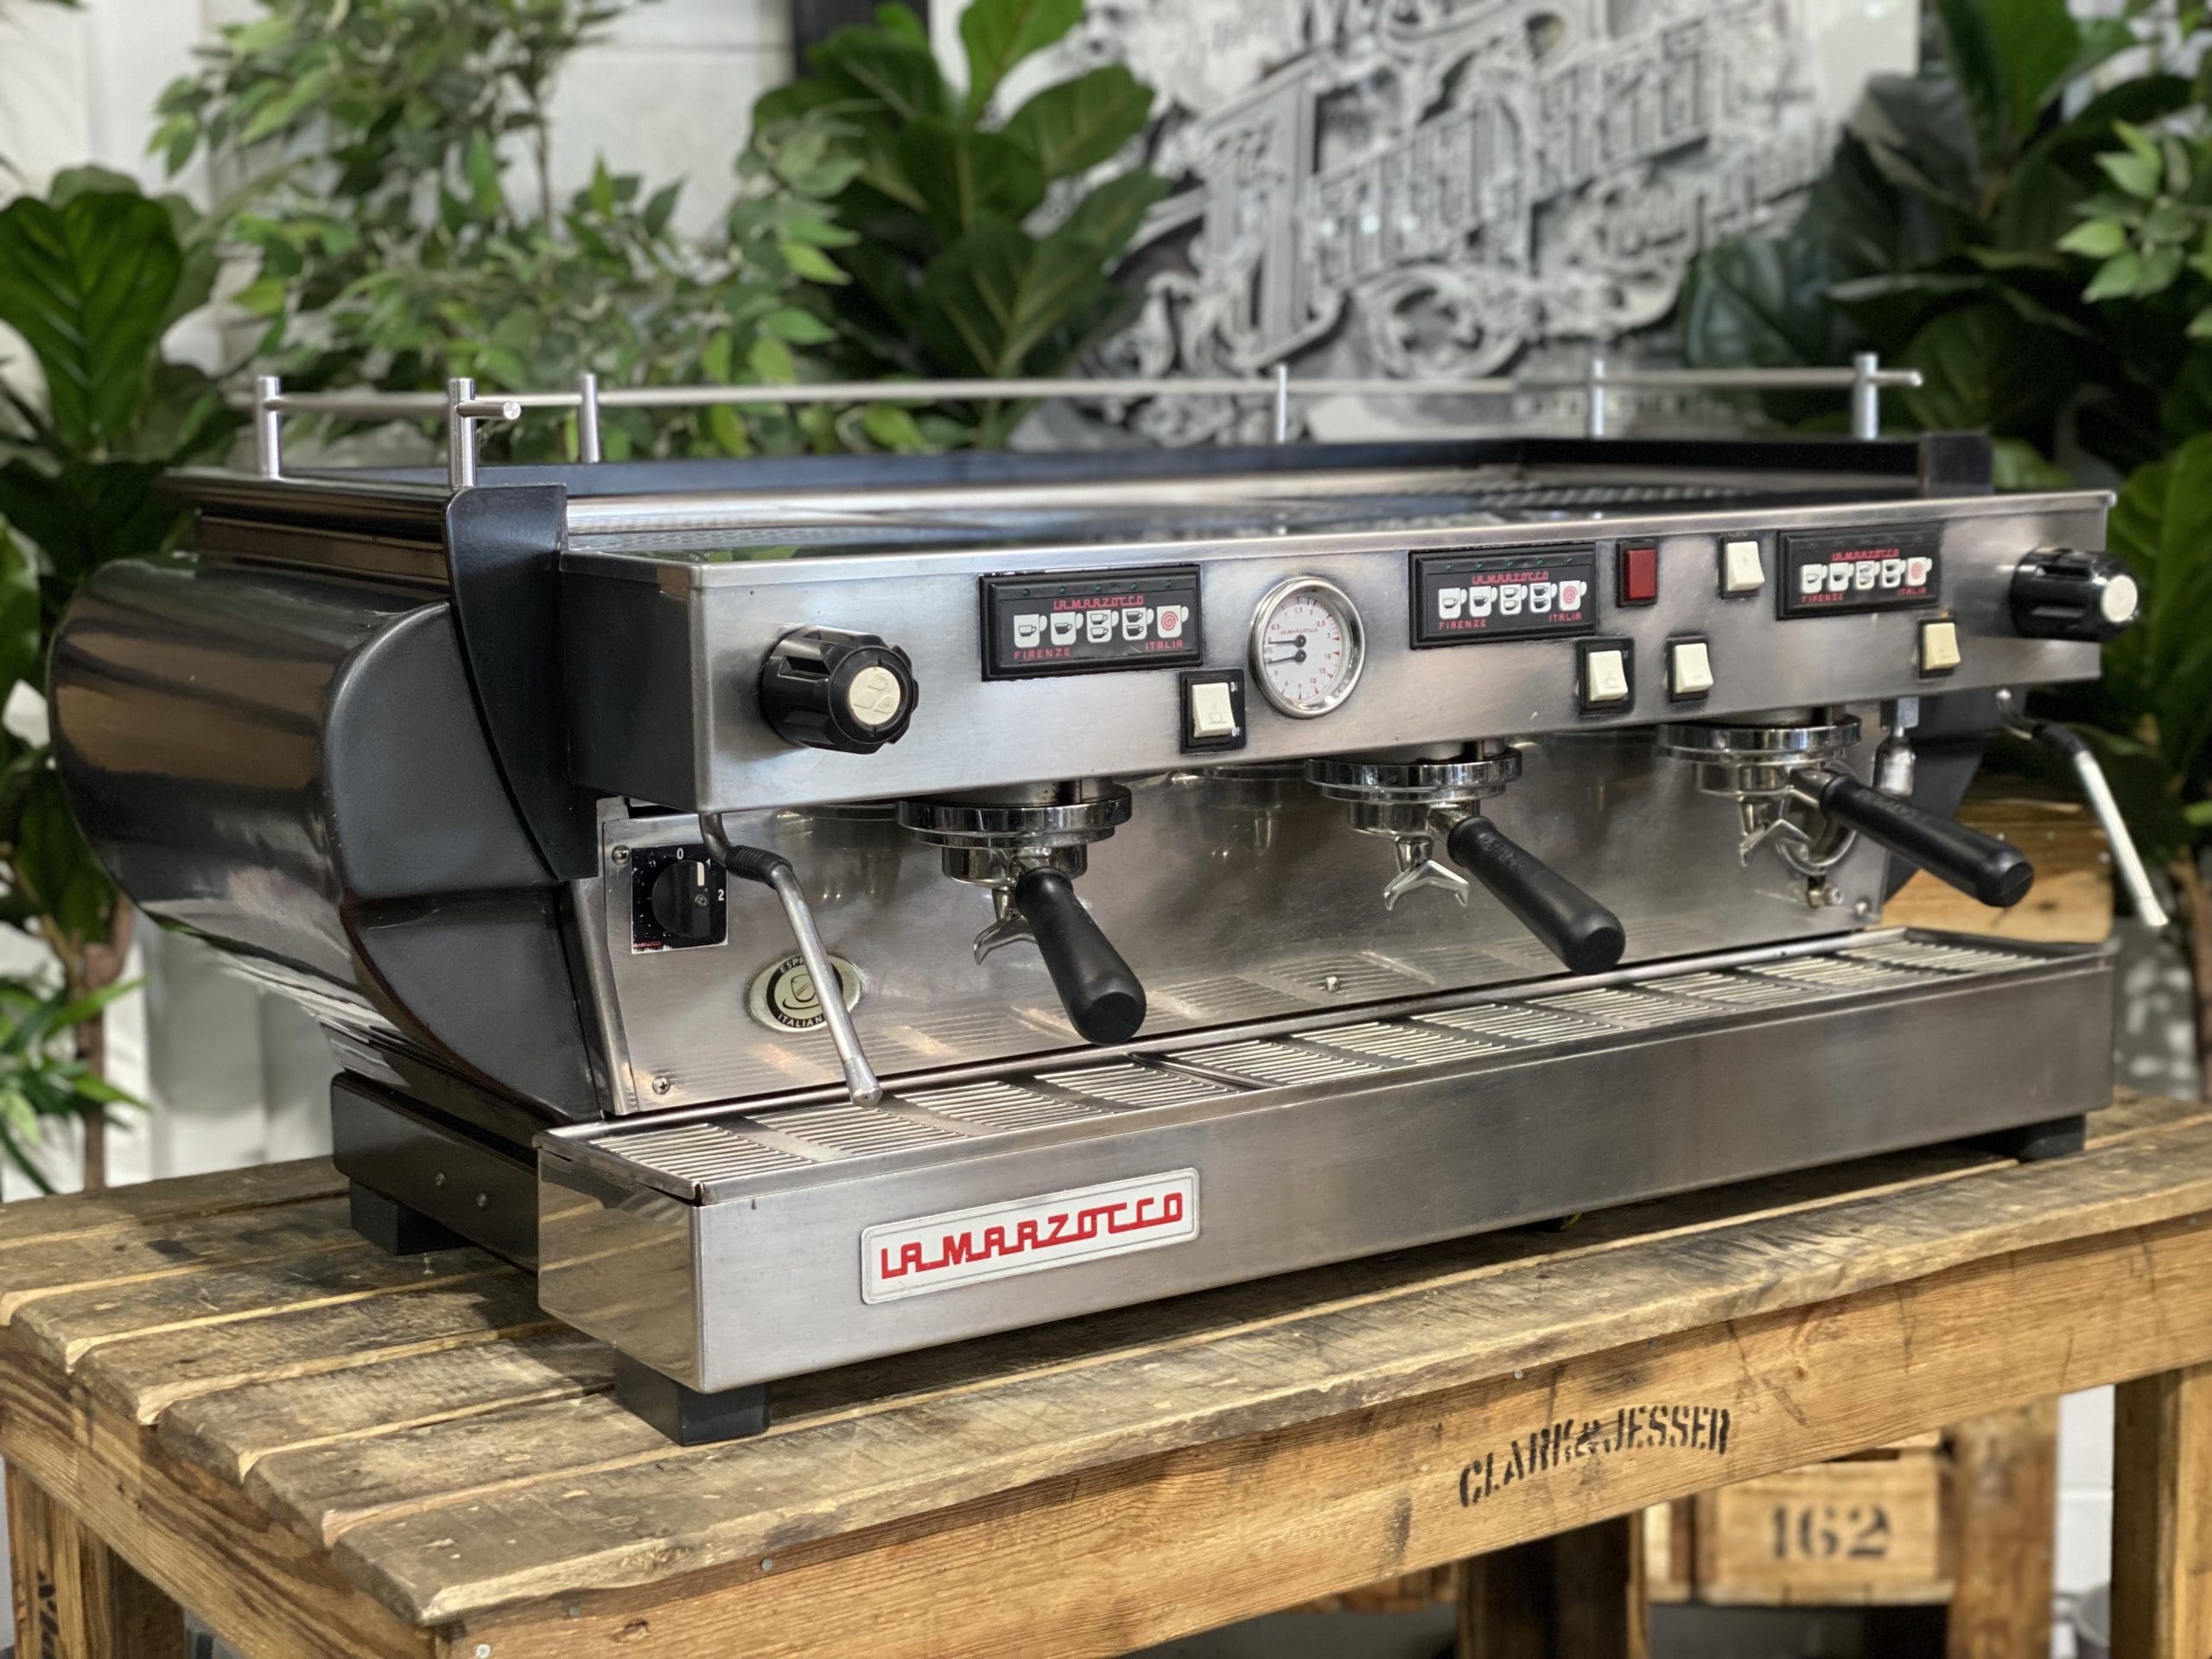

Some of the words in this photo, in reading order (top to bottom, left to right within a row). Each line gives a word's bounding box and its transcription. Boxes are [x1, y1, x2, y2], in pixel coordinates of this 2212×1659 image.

[1471, 574, 1484, 585] LA
[1487, 571, 1548, 583] MARZOCCO
[1802, 593, 1845, 603] FIRENZE
[1897, 587, 1927, 596] ITALIA
[1054, 600, 1066, 610] LA
[1071, 594, 1144, 608] MARZOCCO
[1548, 612, 1582, 622] ITALIA
[1438, 619, 1487, 630] FIRENZE
[1145, 639, 1183, 651] ITALIA
[1014, 647, 1071, 660] FIRENZE
[677, 848, 684, 860] 0
[718, 888, 725, 901] 2
[778, 1013, 823, 1027] ITALIAN
[880, 1241, 922, 1280] LA
[942, 1192, 1184, 1268] MARZOCCO
[1772, 1503, 1891, 1560] 162
